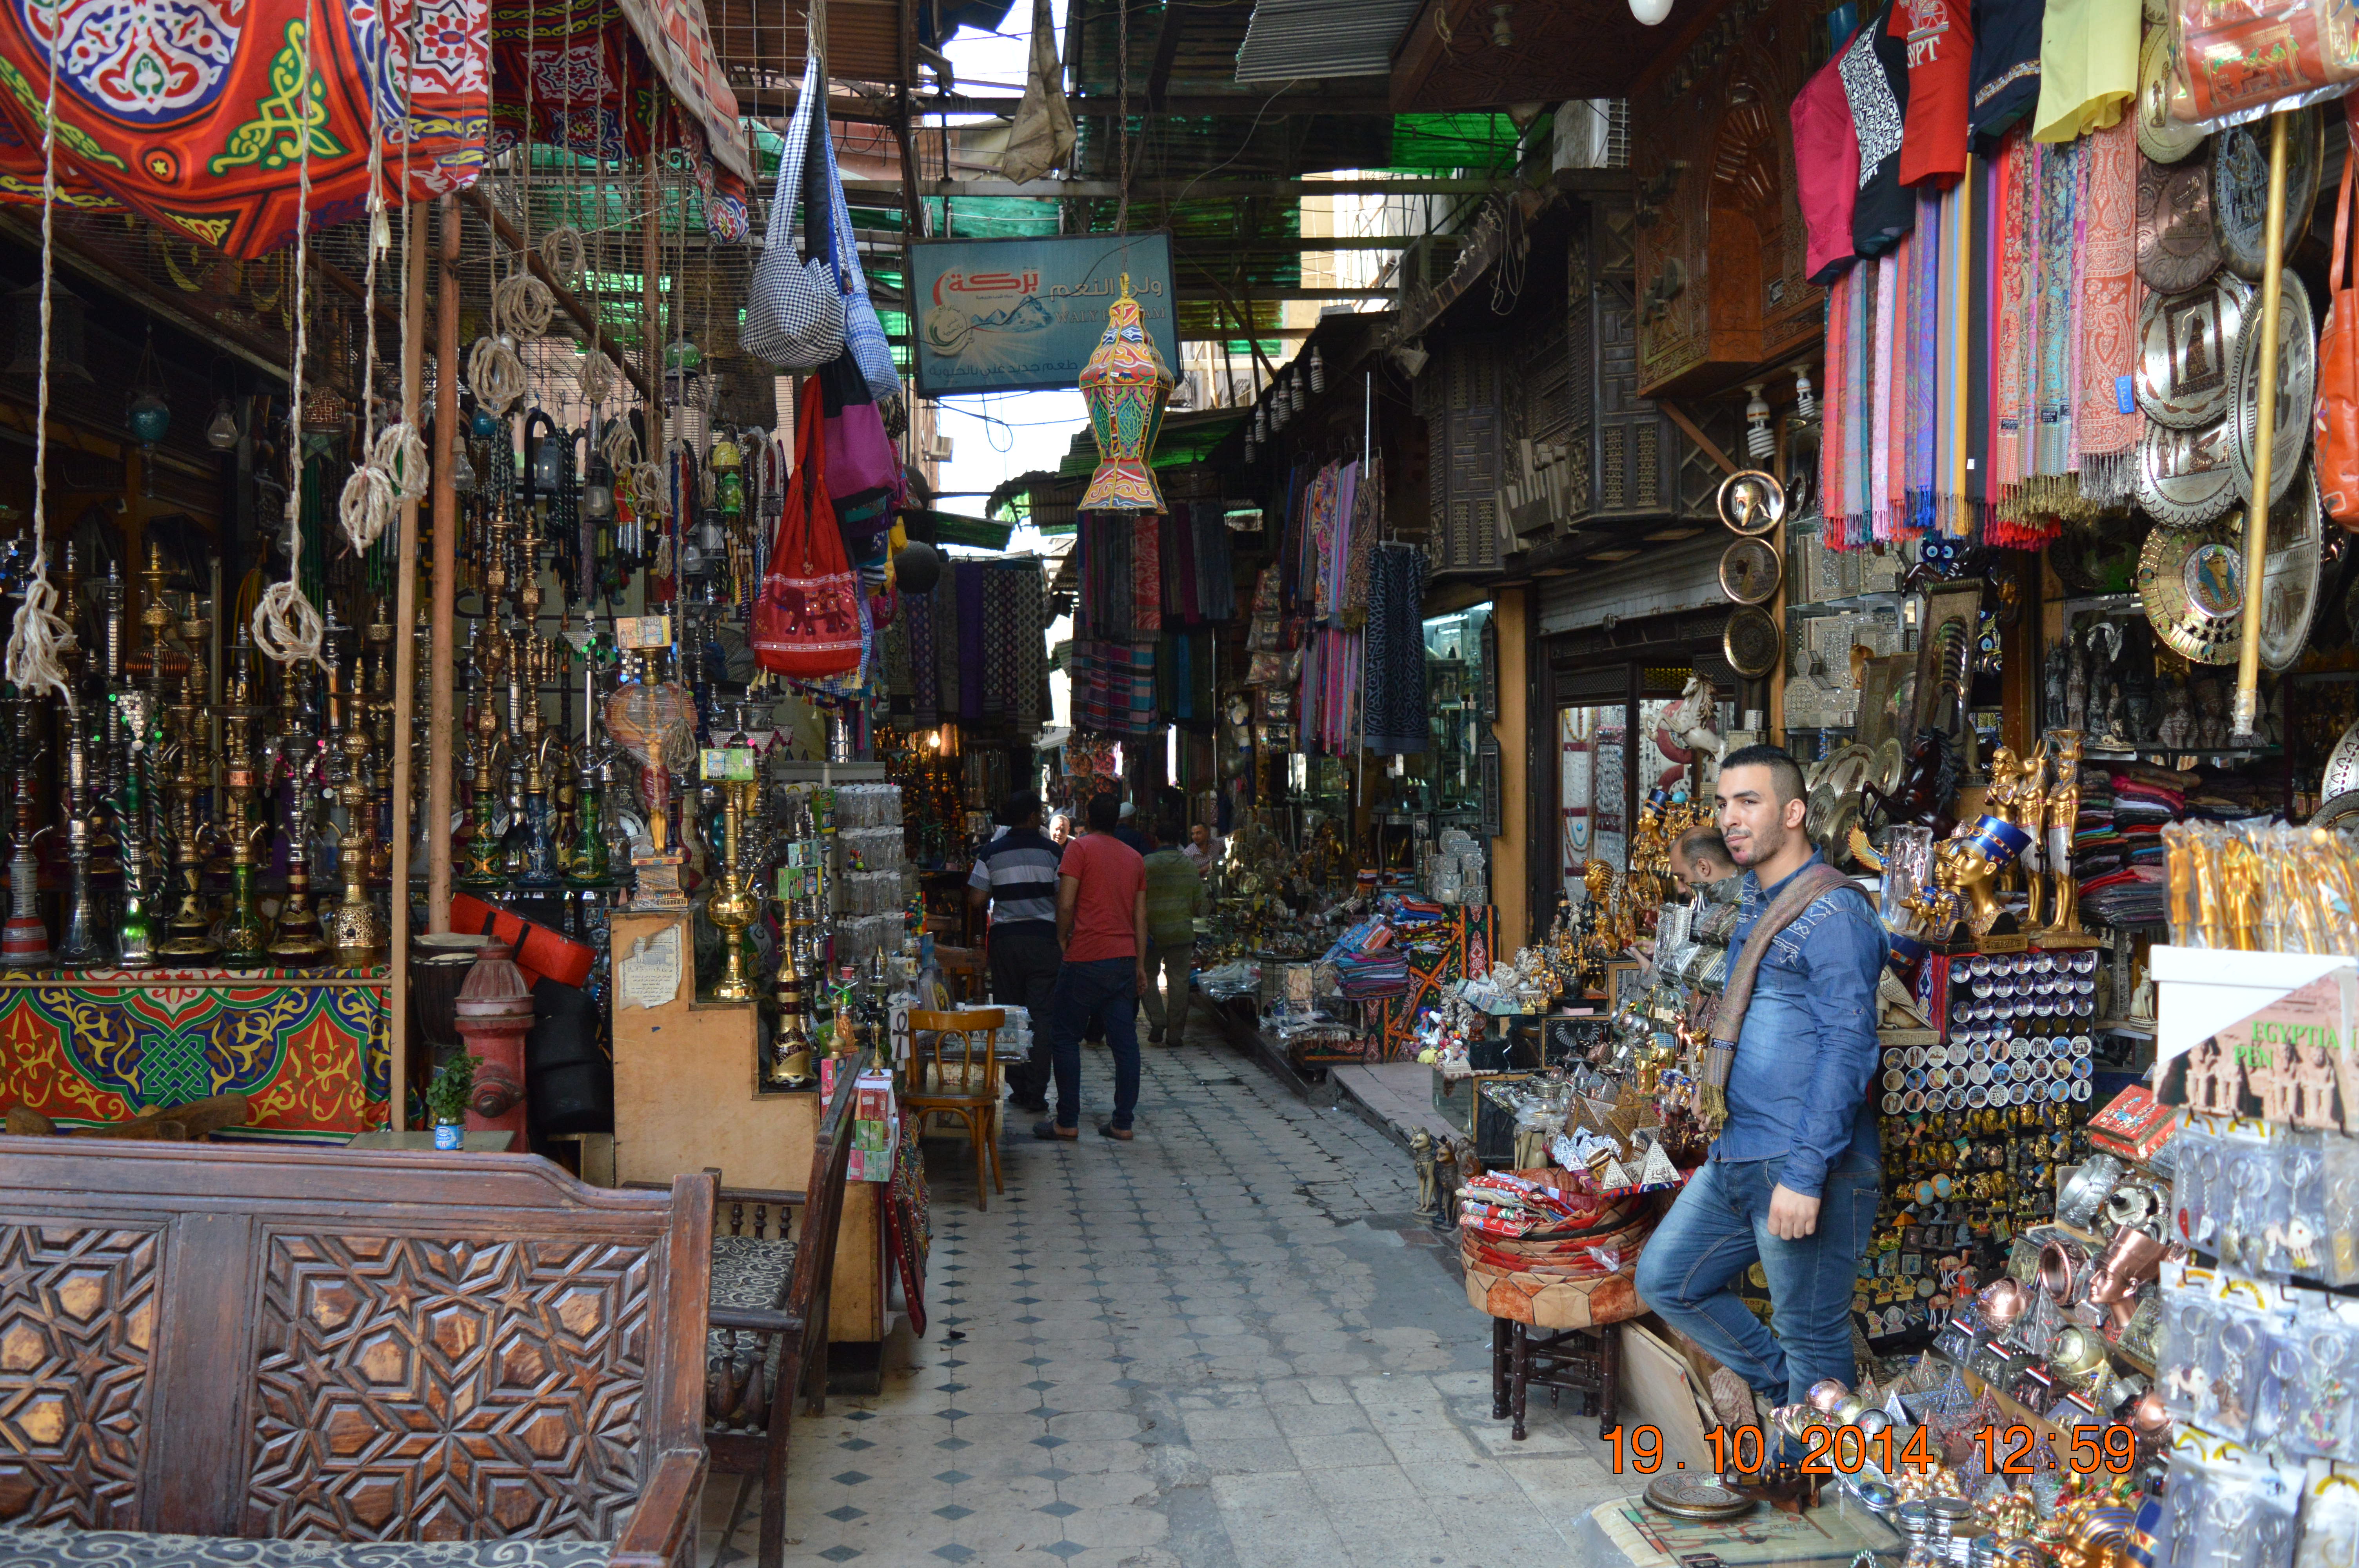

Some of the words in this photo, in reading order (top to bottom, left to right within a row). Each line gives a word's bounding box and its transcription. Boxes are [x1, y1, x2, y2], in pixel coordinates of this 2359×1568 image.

[1907, 35, 1940, 68] YPT
[1050, 277, 1115, 302] النعم
[1056, 311, 1098, 323] WALY
[929, 365, 978, 377] بالحيوية
[1043, 359, 1078, 373] طعم
[2234, 1045, 2273, 1068] PEN
